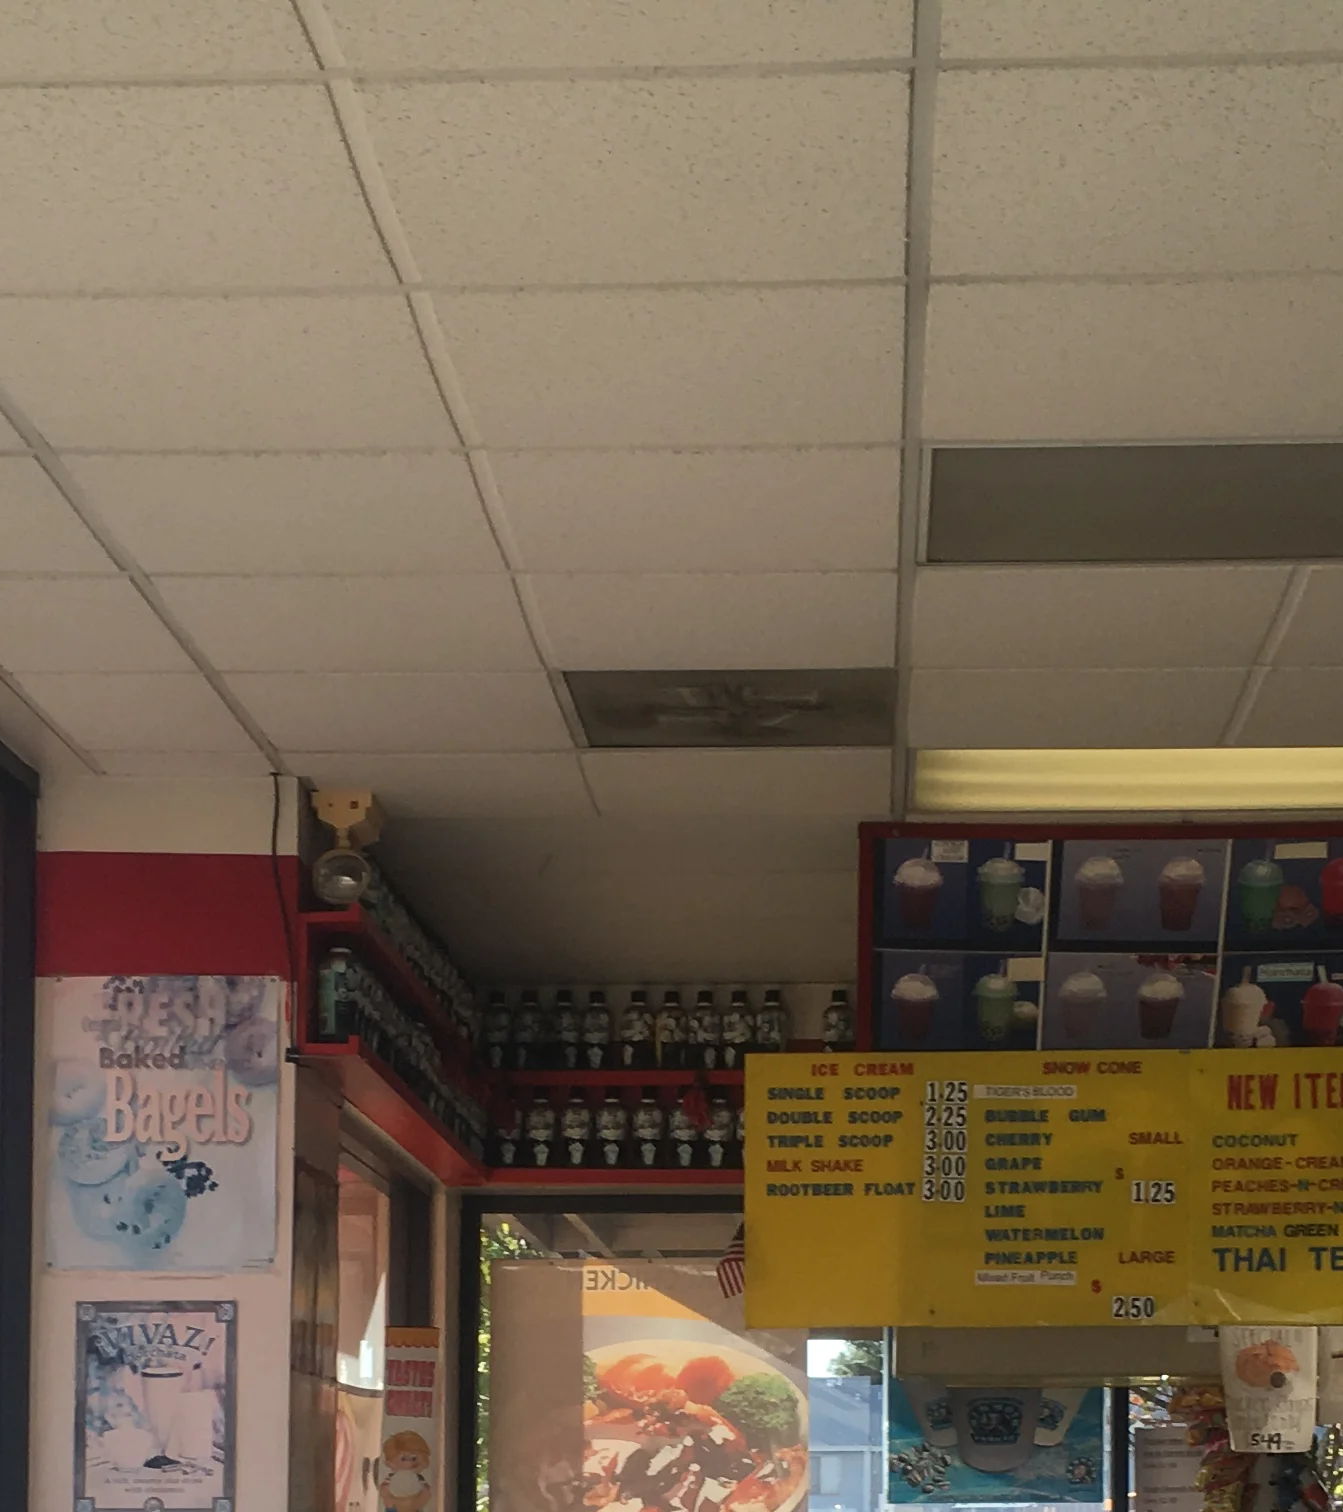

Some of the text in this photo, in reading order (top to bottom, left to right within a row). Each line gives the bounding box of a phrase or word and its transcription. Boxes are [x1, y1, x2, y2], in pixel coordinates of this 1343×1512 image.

[99, 1045, 186, 1070] Baked
[811, 1062, 915, 1077] ICE CREAM
[1042, 1060, 1142, 1075] SNOW CONE
[767, 1082, 968, 1102] SINGLE SCOOP 1.25
[1227, 1074, 1279, 1111] NEW
[106, 1067, 253, 1162] Bagels
[767, 1106, 966, 1127] DOUBLE SCOOP 2.25
[985, 1109, 1106, 1123] BUBBLE GUM
[767, 1130, 966, 1150] TRIPLE SCOOP 3.00
[985, 1133, 1053, 1147] CHERRY
[1129, 1132, 1183, 1146] SMALL
[1212, 1133, 1298, 1148] COCONUT
[767, 1156, 965, 1177] MILK SHAKE 3.00
[985, 1157, 1042, 1171] GRAPE
[766, 1179, 965, 1201] ROOTBEER FLOAT 3.00
[985, 1180, 1103, 1195] STRAWBERRY
[1132, 1181, 1175, 1203] 1.25
[985, 1204, 1026, 1219] LIME
[985, 1228, 1105, 1242] WATERMELON
[1212, 1224, 1277, 1239] MATCHA
[1284, 1223, 1339, 1238] GREEN
[984, 1251, 1078, 1265] PINEAPPLE
[1118, 1250, 1175, 1265] LARGE
[1212, 1247, 1287, 1273] THAI
[1112, 1298, 1155, 1320] 2.50
[99, 1322, 218, 1356] VIVAZ!
